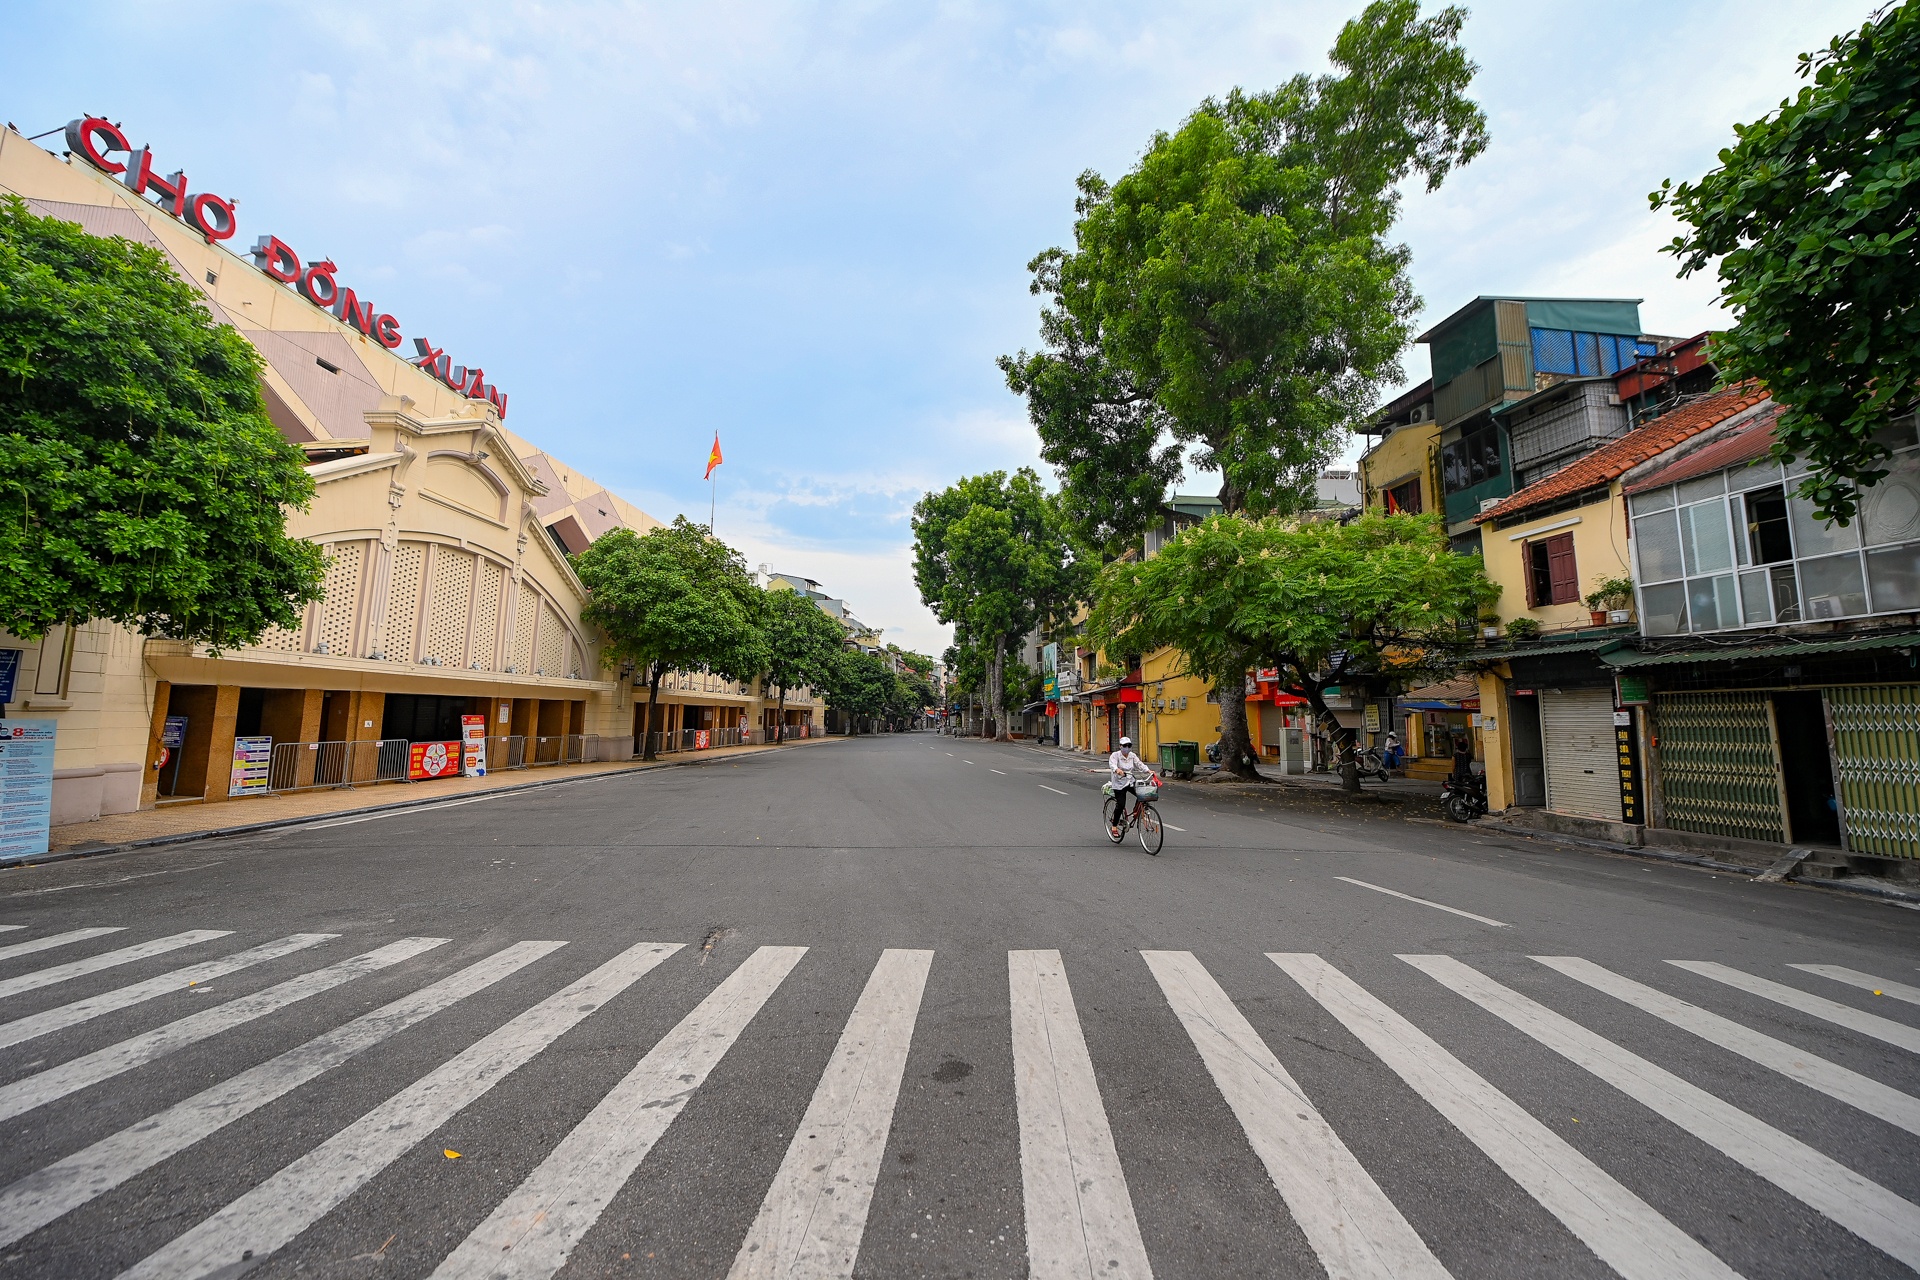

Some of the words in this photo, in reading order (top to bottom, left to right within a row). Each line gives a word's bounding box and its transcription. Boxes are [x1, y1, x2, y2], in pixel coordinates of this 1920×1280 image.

[66, 117, 236, 244] CHỢ
[414, 337, 508, 419] XUÂN
[13, 728, 24, 736] 8
